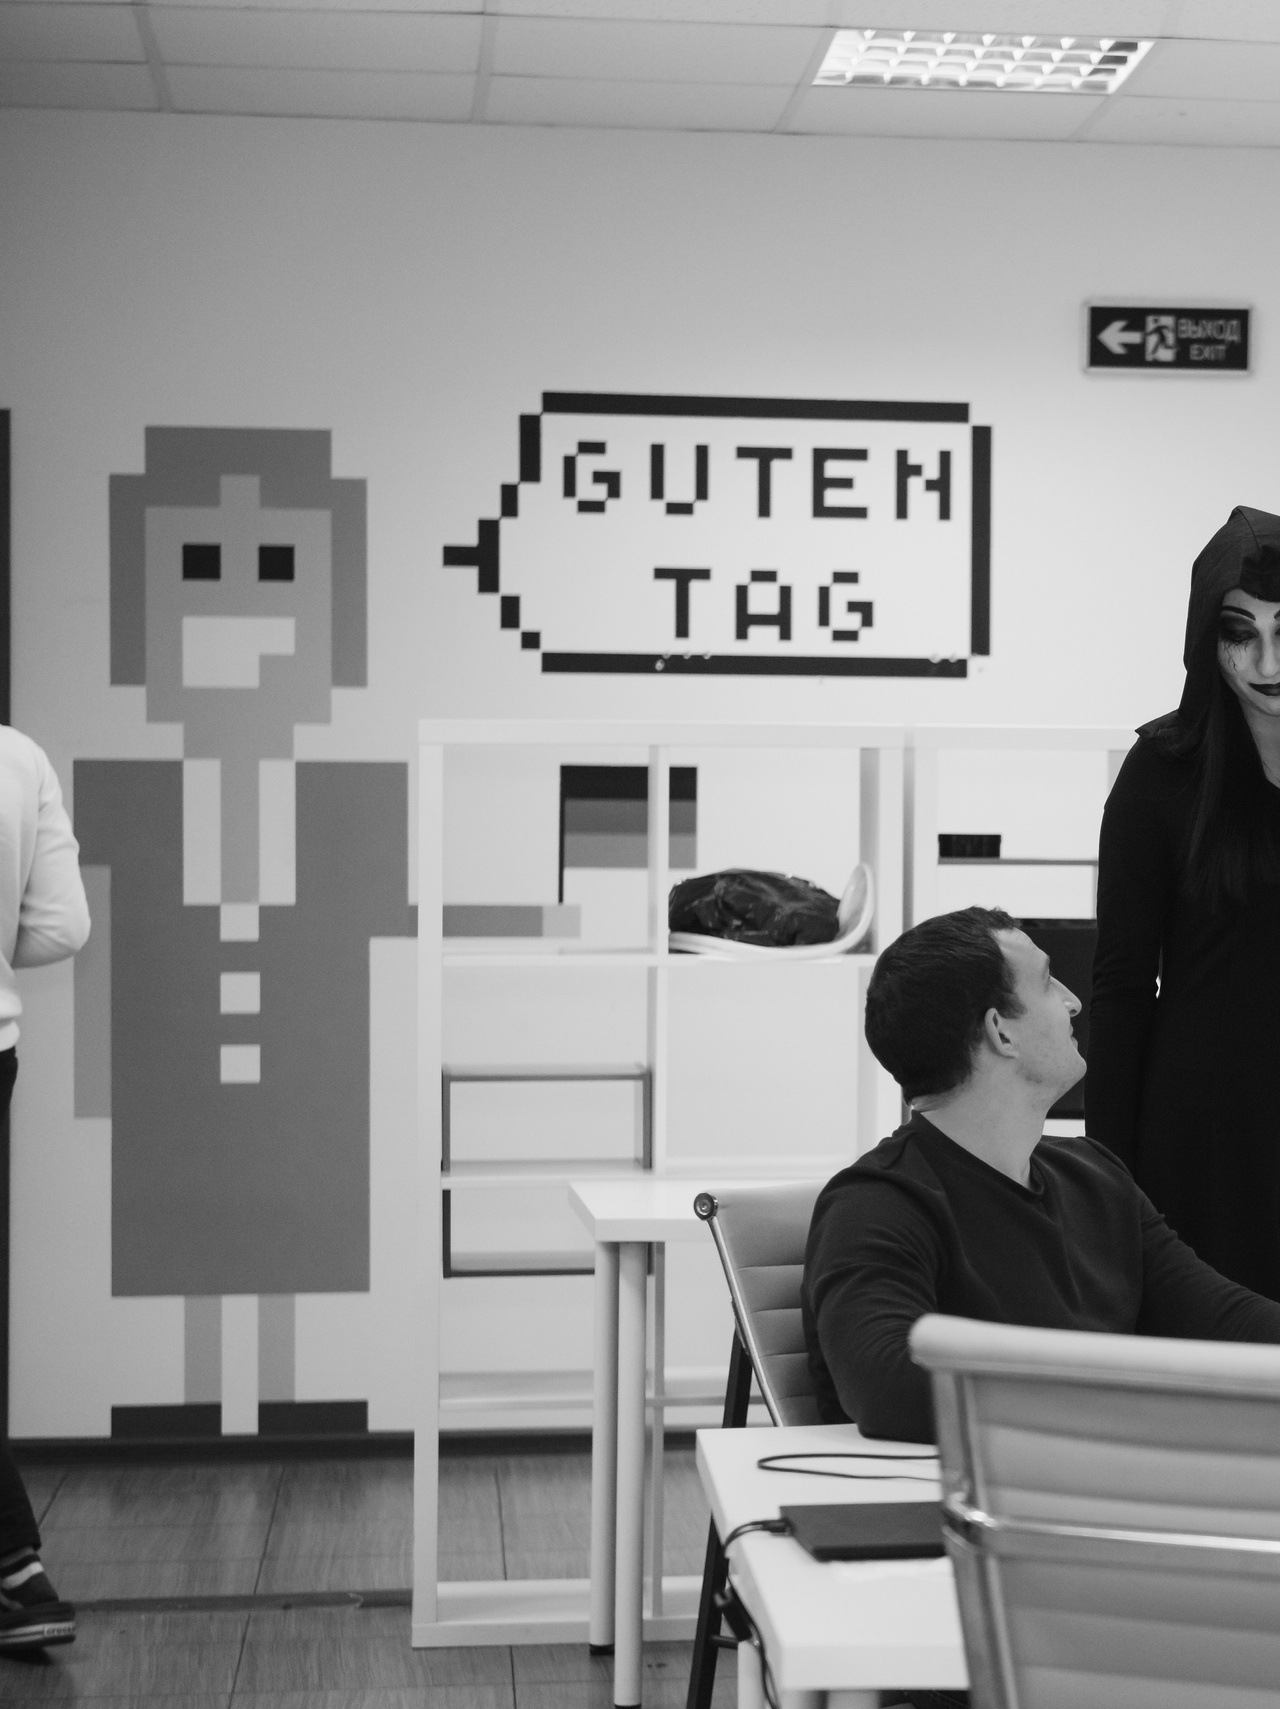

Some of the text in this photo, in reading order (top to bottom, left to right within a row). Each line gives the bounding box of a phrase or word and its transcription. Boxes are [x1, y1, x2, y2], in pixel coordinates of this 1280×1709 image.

[1177, 318, 1241, 343] ВЫХОД
[1189, 343, 1226, 361] EXIT
[563, 441, 951, 520] GUTEN
[653, 567, 873, 641] TAG
